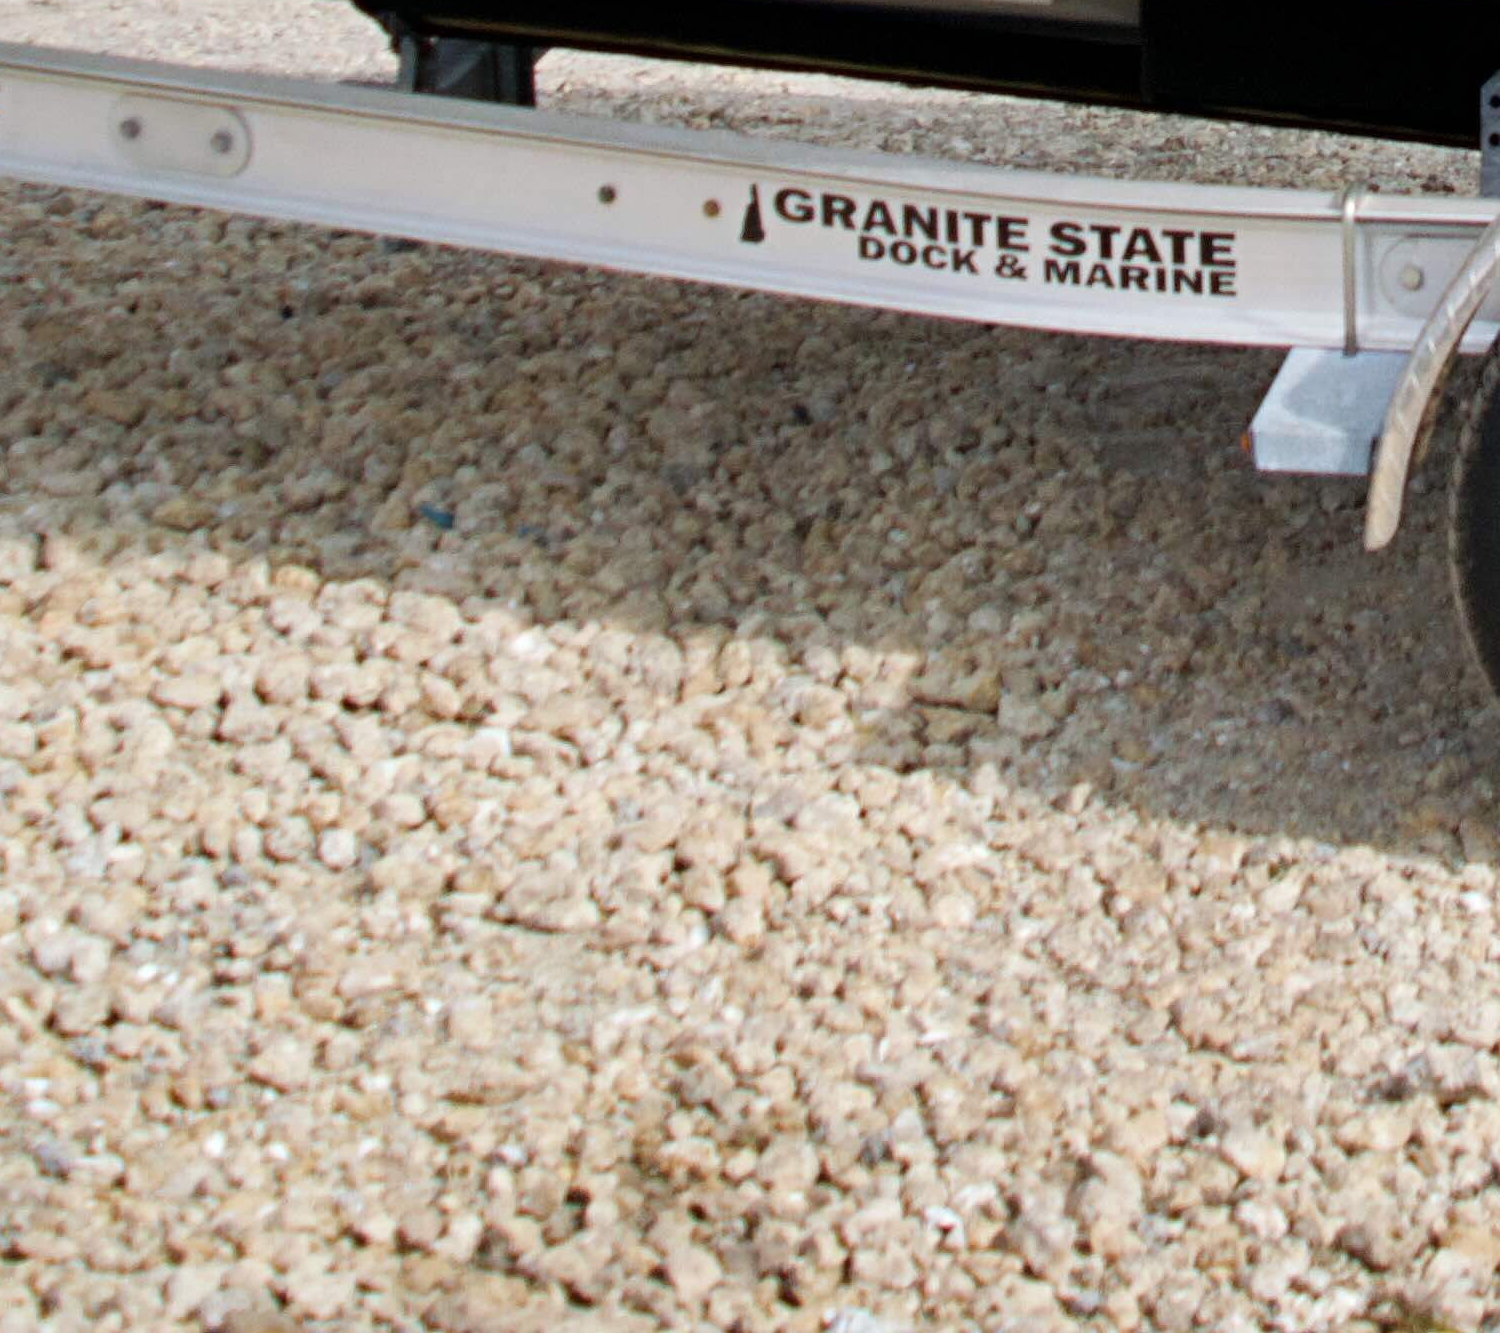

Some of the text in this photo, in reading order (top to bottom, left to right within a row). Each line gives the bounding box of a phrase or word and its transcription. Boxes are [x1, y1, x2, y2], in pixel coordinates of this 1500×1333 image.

[773, 187, 1237, 267] GRANITE STATE
[858, 235, 1237, 297] DOCK & MARINE
